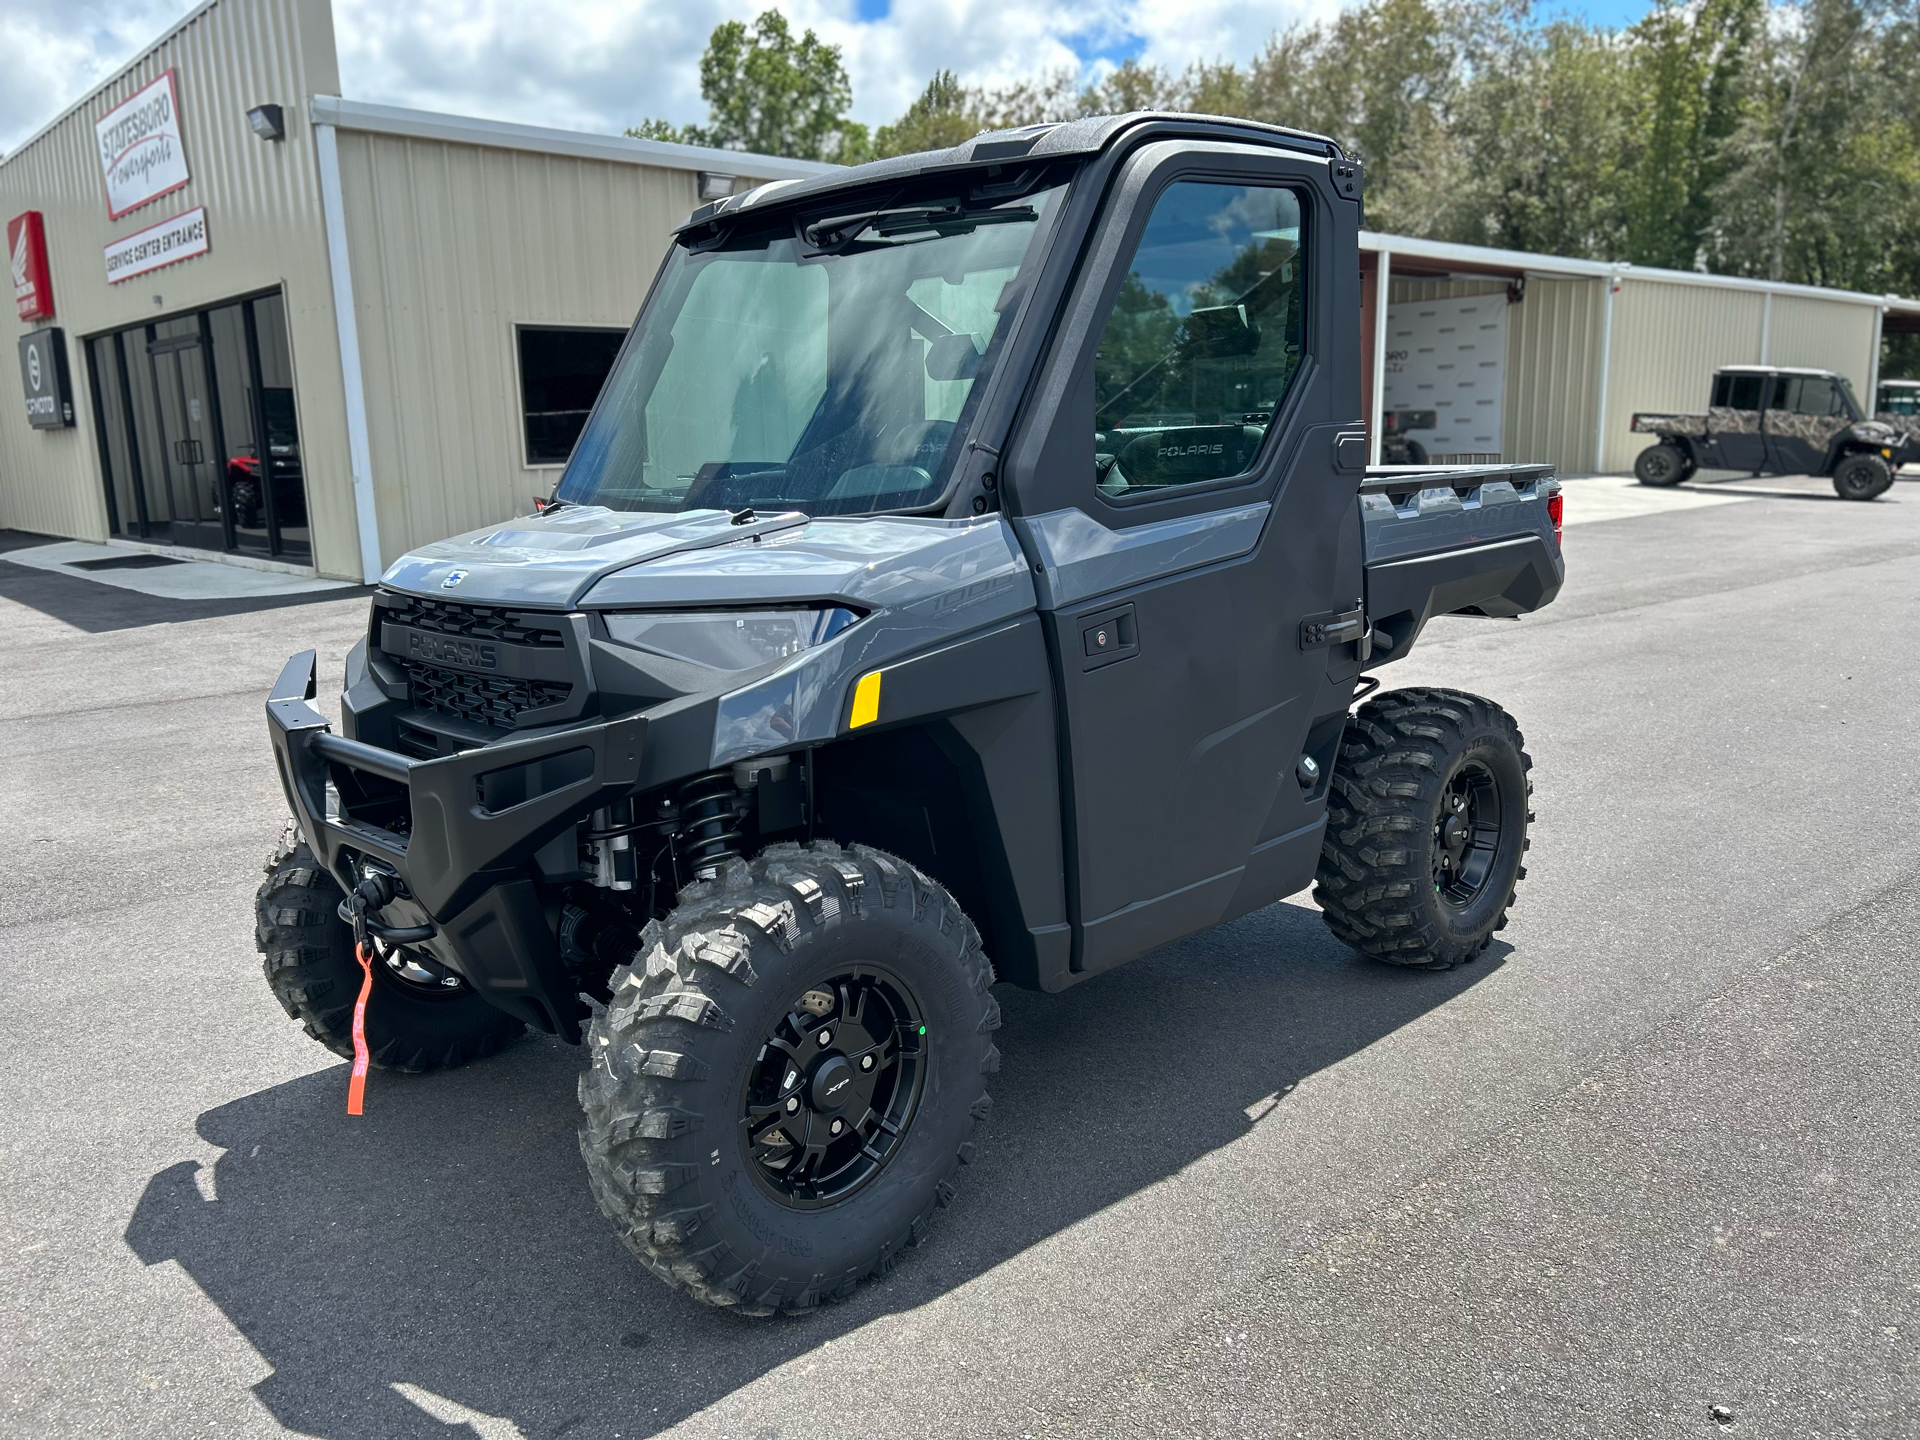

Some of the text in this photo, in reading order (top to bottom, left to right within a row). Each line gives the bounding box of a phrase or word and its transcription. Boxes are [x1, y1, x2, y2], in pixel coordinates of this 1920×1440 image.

[102, 92, 170, 160] STATESBORO
[110, 130, 172, 191] Powersports
[106, 220, 203, 272] SERVICE CENTER ENTRANCE
[1157, 443, 1224, 458] POLARIS
[1437, 502, 1529, 533] RANGER
[409, 632, 497, 670] POLARIS
[891, 928, 968, 1026] X-TERRAIN
[353, 1002, 368, 1077] POLARIS
[825, 1077, 851, 1096] XP
[729, 1186, 813, 1258] PRO ARMOR
